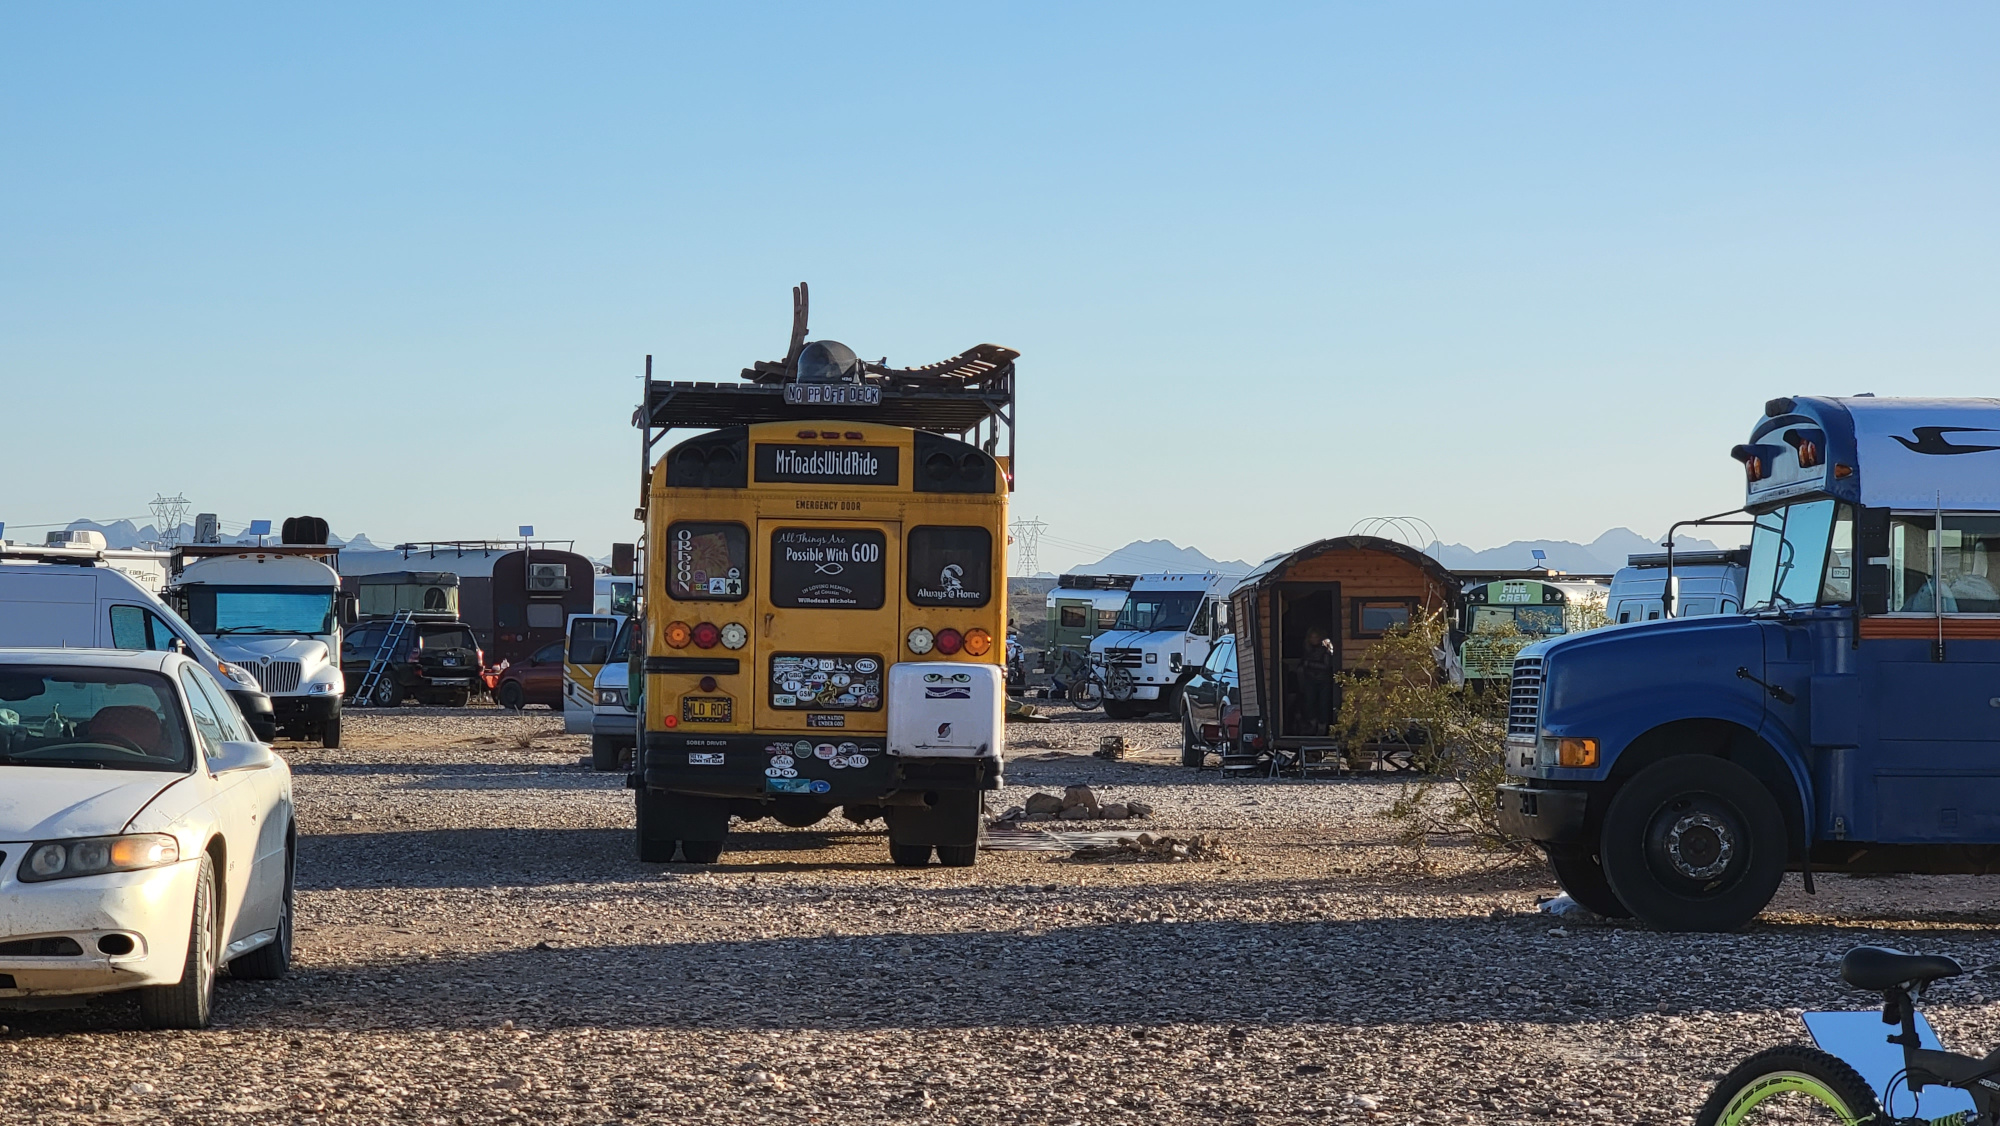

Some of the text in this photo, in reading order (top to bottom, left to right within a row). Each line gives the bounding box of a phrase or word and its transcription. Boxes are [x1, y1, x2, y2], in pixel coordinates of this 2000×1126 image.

[788, 384, 879, 404] NO PP OFF DECK
[776, 450, 878, 476] MrToadsWildRide
[796, 501, 860, 510] EMERGENCY DOOR
[778, 532, 846, 546] All Things Are
[786, 543, 878, 562] Possible With GOD
[678, 530, 692, 592] OREGON
[809, 584, 828, 592] LOVING
[830, 584, 852, 594] MEMORY
[1502, 584, 1527, 593] FINE
[917, 588, 946, 600] Always
[956, 590, 980, 598] Home
[1499, 594, 1531, 602] CREW
[788, 682, 796, 690] U
[866, 686, 878, 694] 66
[851, 756, 867, 764] MO
